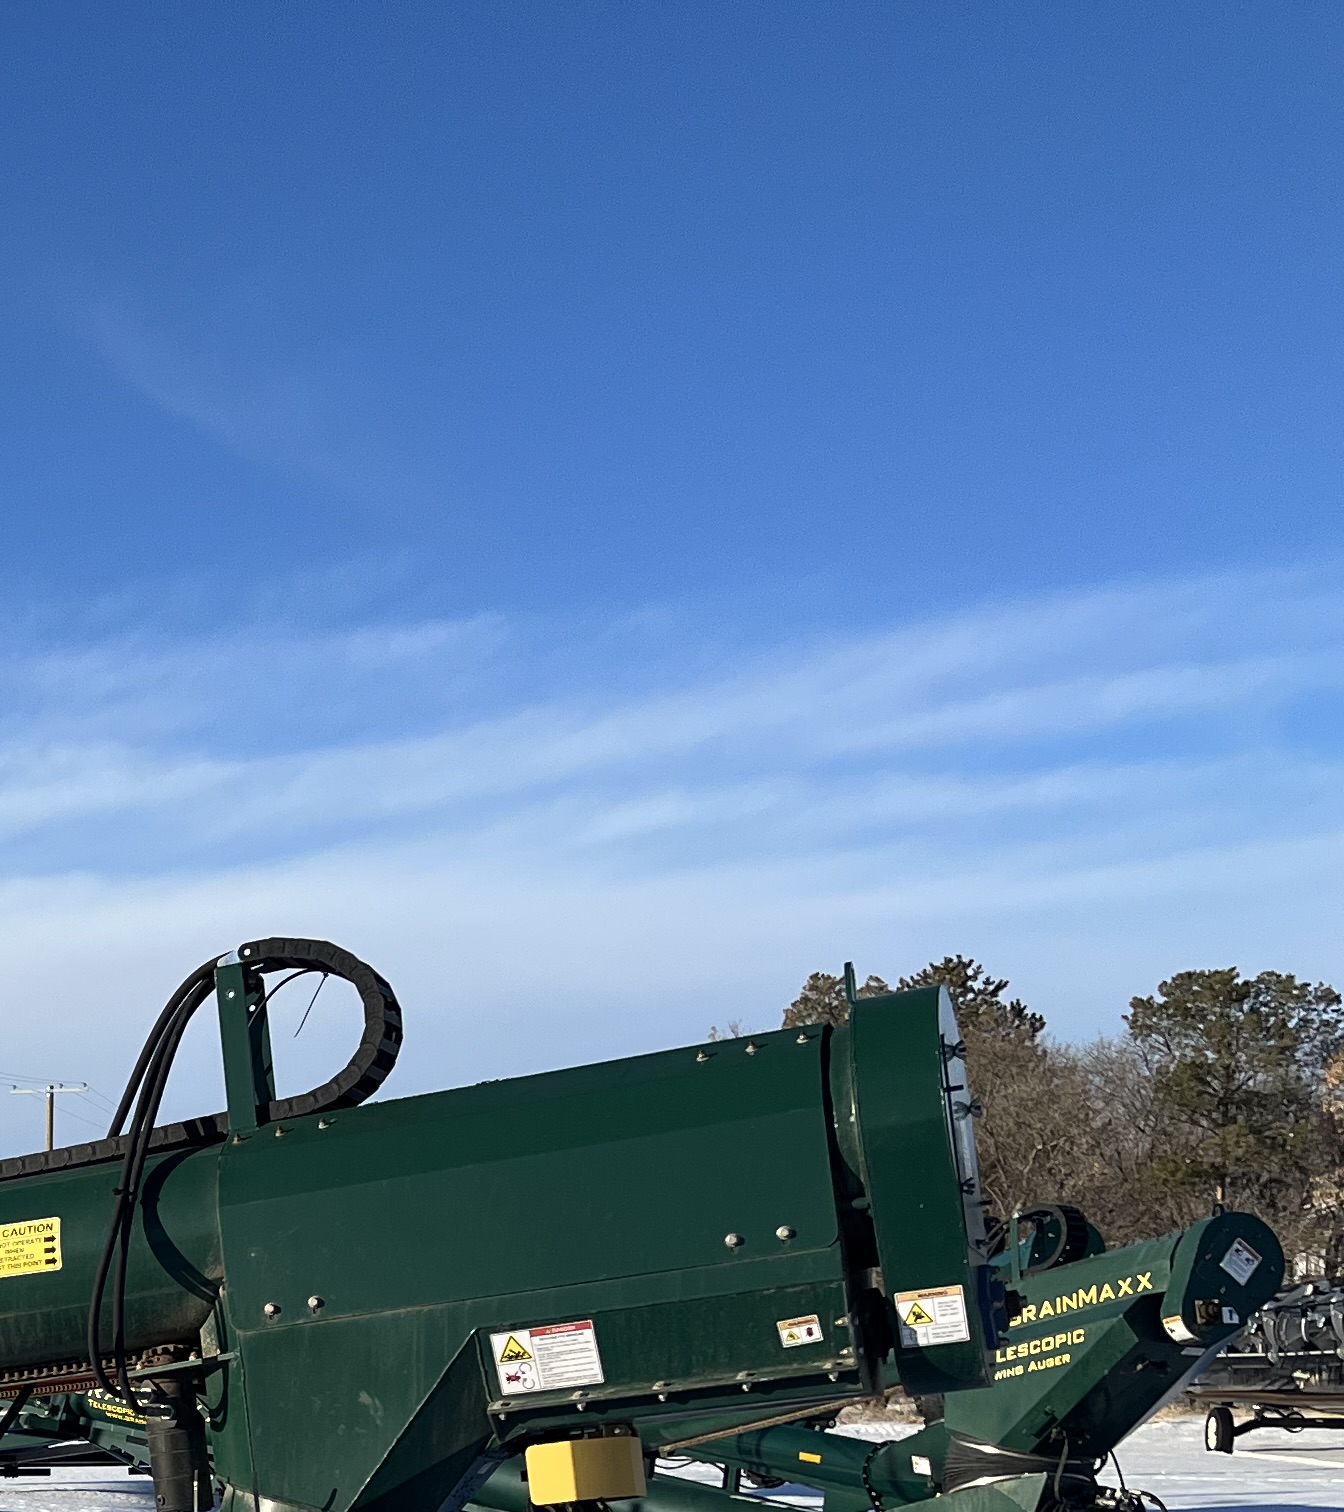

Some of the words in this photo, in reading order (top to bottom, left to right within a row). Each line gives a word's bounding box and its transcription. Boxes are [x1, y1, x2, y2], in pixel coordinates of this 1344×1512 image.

[2, 1223, 54, 1238] CAUTION
[995, 1328, 1086, 1364] LESCOPIC
[1027, 1353, 1071, 1373] AUGER
